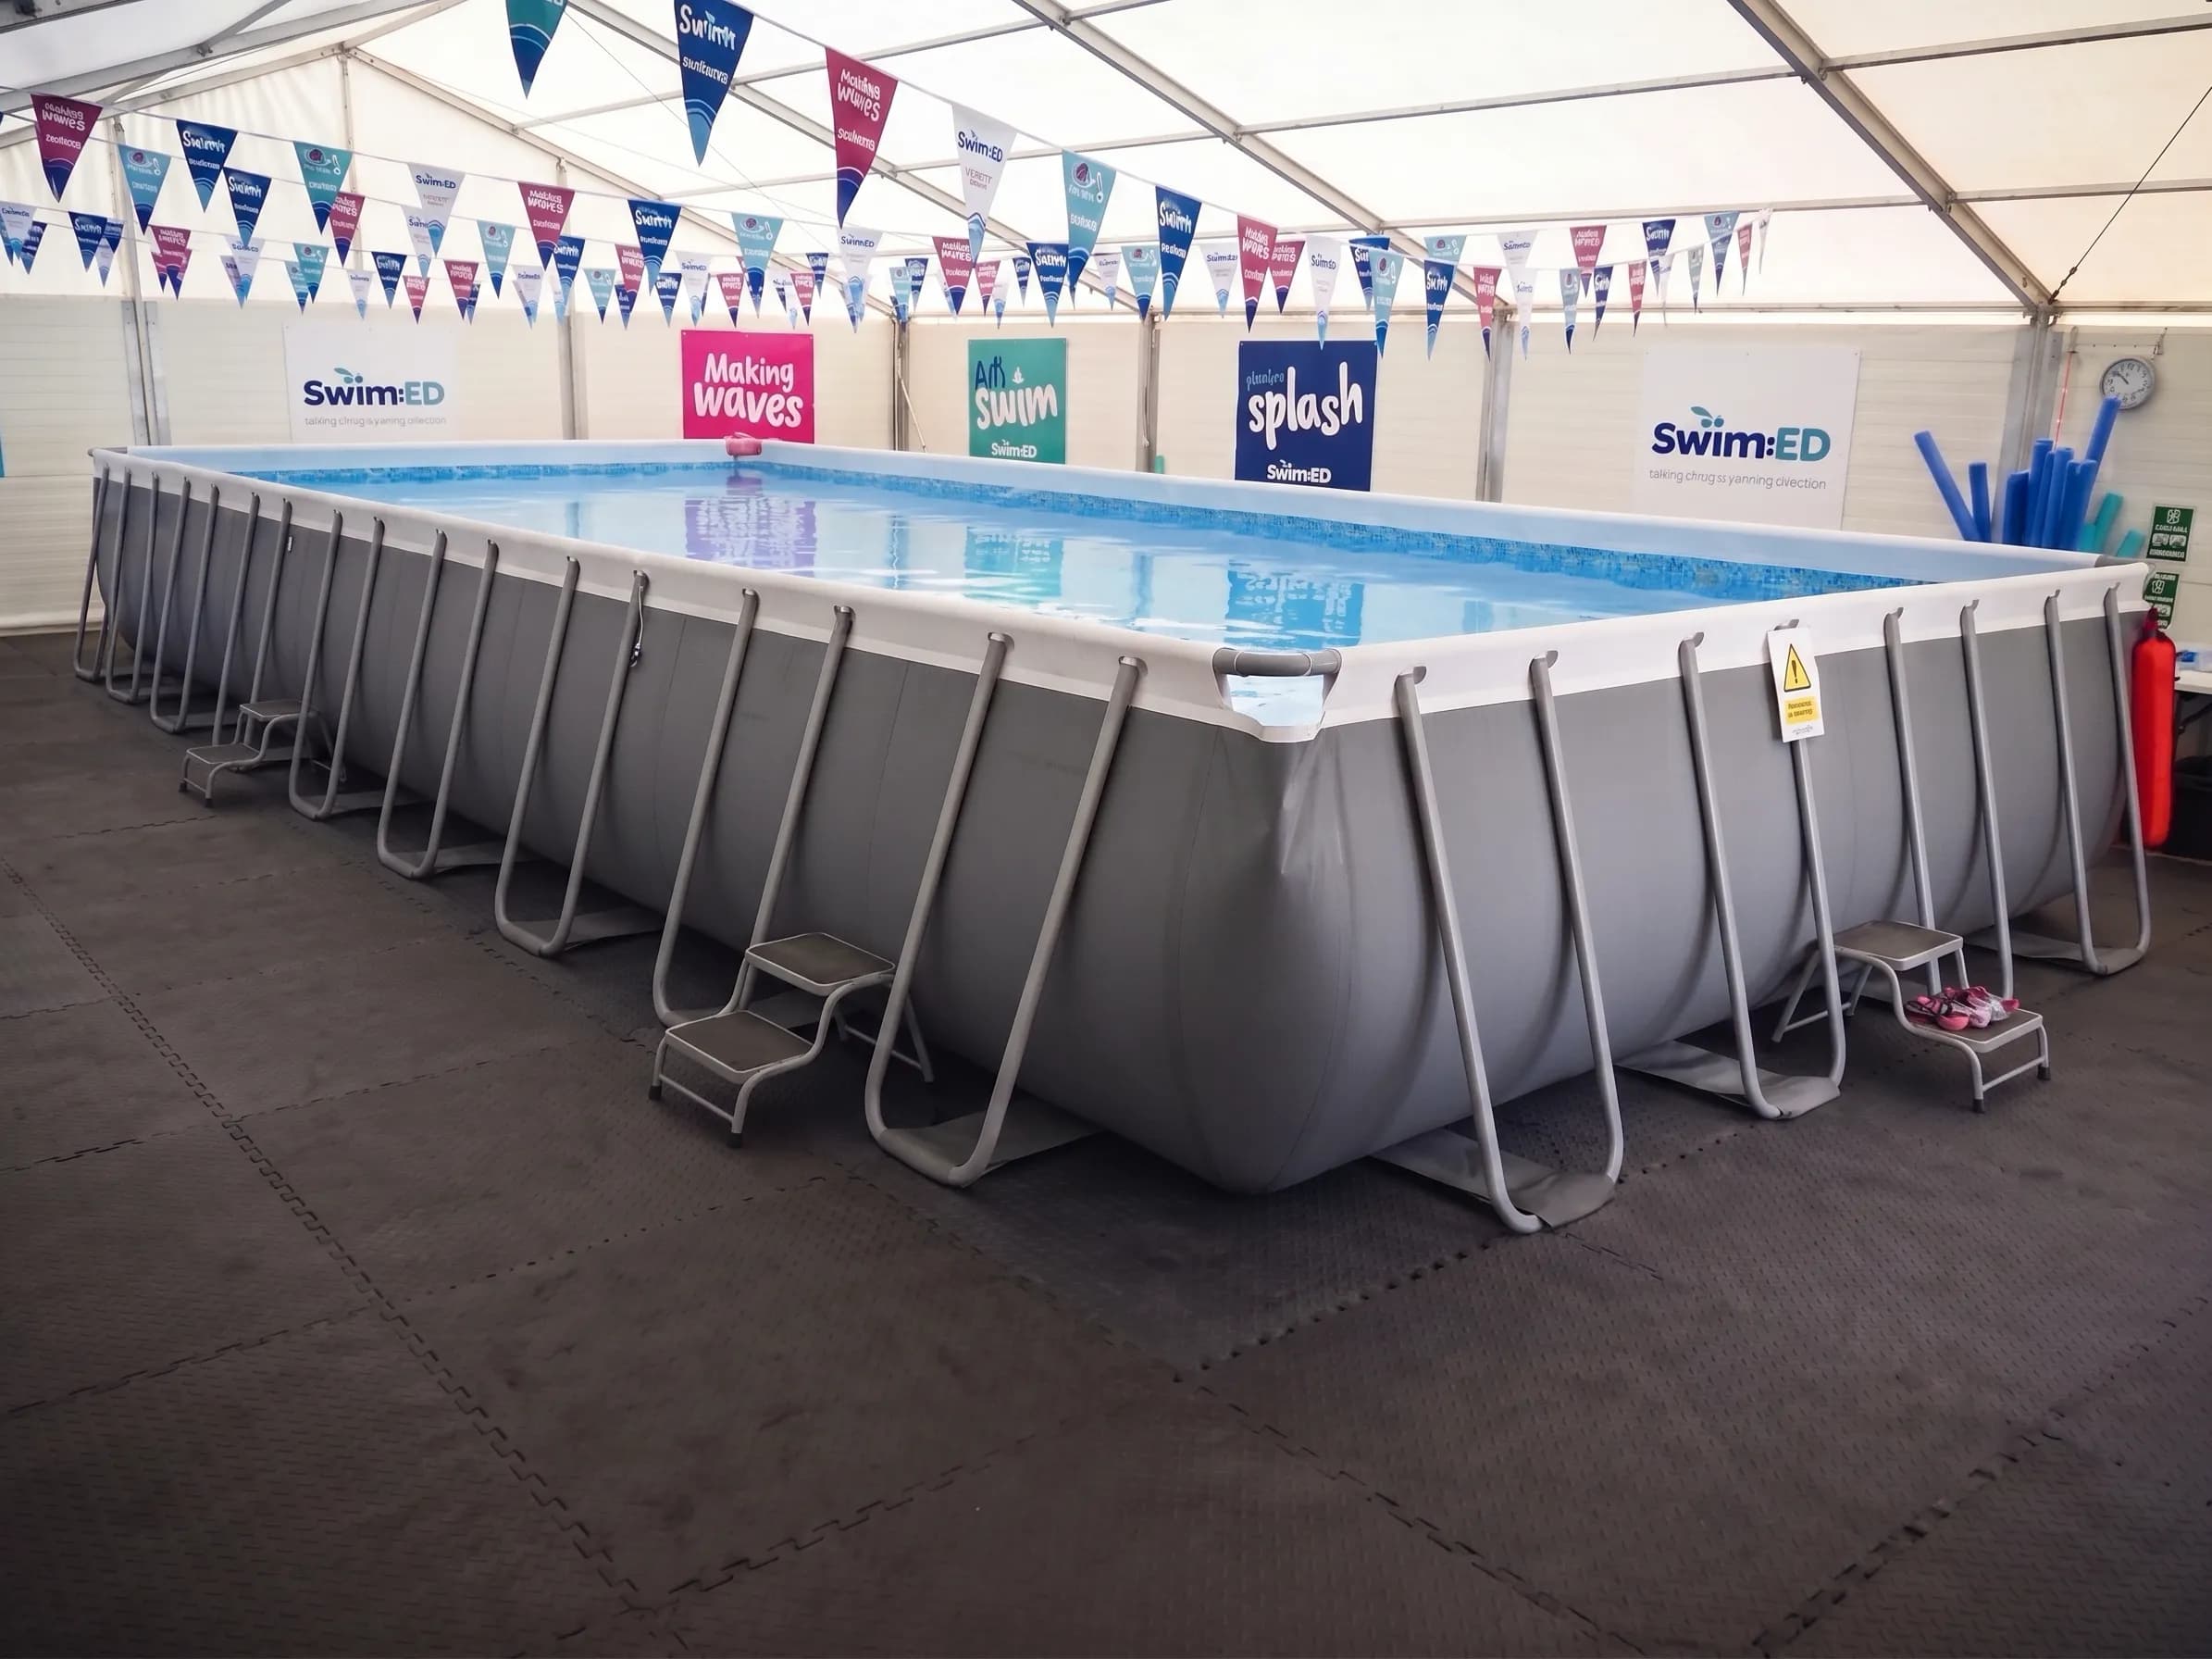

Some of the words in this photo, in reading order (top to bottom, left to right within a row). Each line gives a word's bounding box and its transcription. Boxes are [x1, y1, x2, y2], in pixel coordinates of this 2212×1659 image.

[703, 353, 794, 393] Making
[303, 377, 445, 405] Swim:ED
[693, 381, 804, 429] waves
[1248, 361, 1363, 451] splash
[990, 441, 1038, 458] Swim:ED
[1651, 418, 1832, 462] Swim:ED
[1266, 462, 1333, 483] Swim:ED
[1648, 468, 1684, 484] talking
